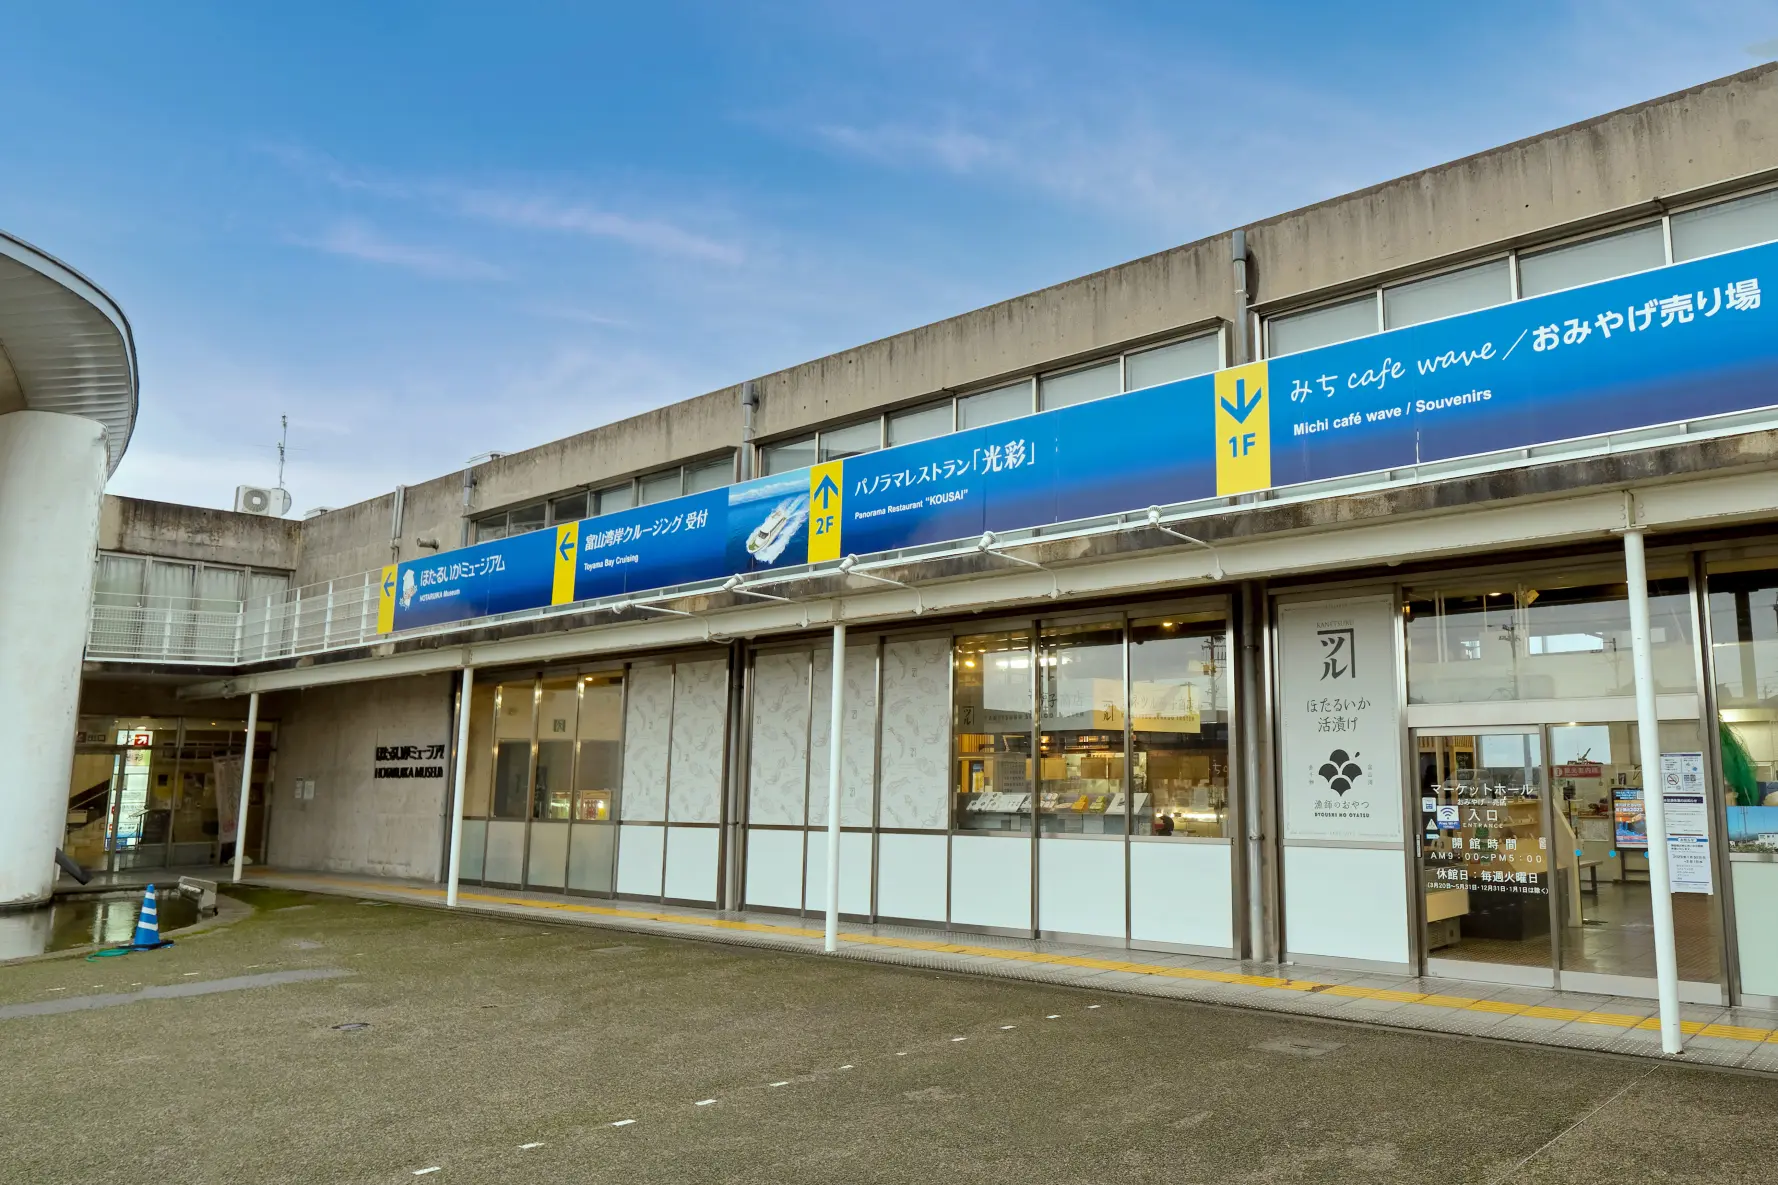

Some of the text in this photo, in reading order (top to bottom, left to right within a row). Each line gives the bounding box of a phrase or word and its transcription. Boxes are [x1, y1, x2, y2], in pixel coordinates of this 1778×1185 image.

[1290, 373, 1338, 403] みち
[1348, 357, 1405, 389] cafe
[1417, 340, 1496, 376] wave
[1532, 278, 1761, 352] おみやげ売り場
[1293, 418, 1328, 436] Michi
[1333, 411, 1362, 429] café
[1365, 405, 1401, 423] wave
[1415, 388, 1492, 413] Souvenirs
[1228, 432, 1256, 458] 1F
[855, 438, 1035, 497] パノラマレストラン「光彩」
[855, 507, 886, 520] Panorama
[887, 500, 923, 514] Restaurant
[584, 508, 709, 552] 富山湾岸クルージング 受付
[815, 515, 834, 535] 2F
[420, 554, 506, 587] ほたるいかミュージアム
[584, 554, 639, 571] Toyama Bay Cruising
[1306, 697, 1371, 713] ほたるいか
[1317, 716, 1359, 733] 活漬け
[1430, 783, 1533, 796] マーケットホール
[1468, 808, 1498, 821] 入口
